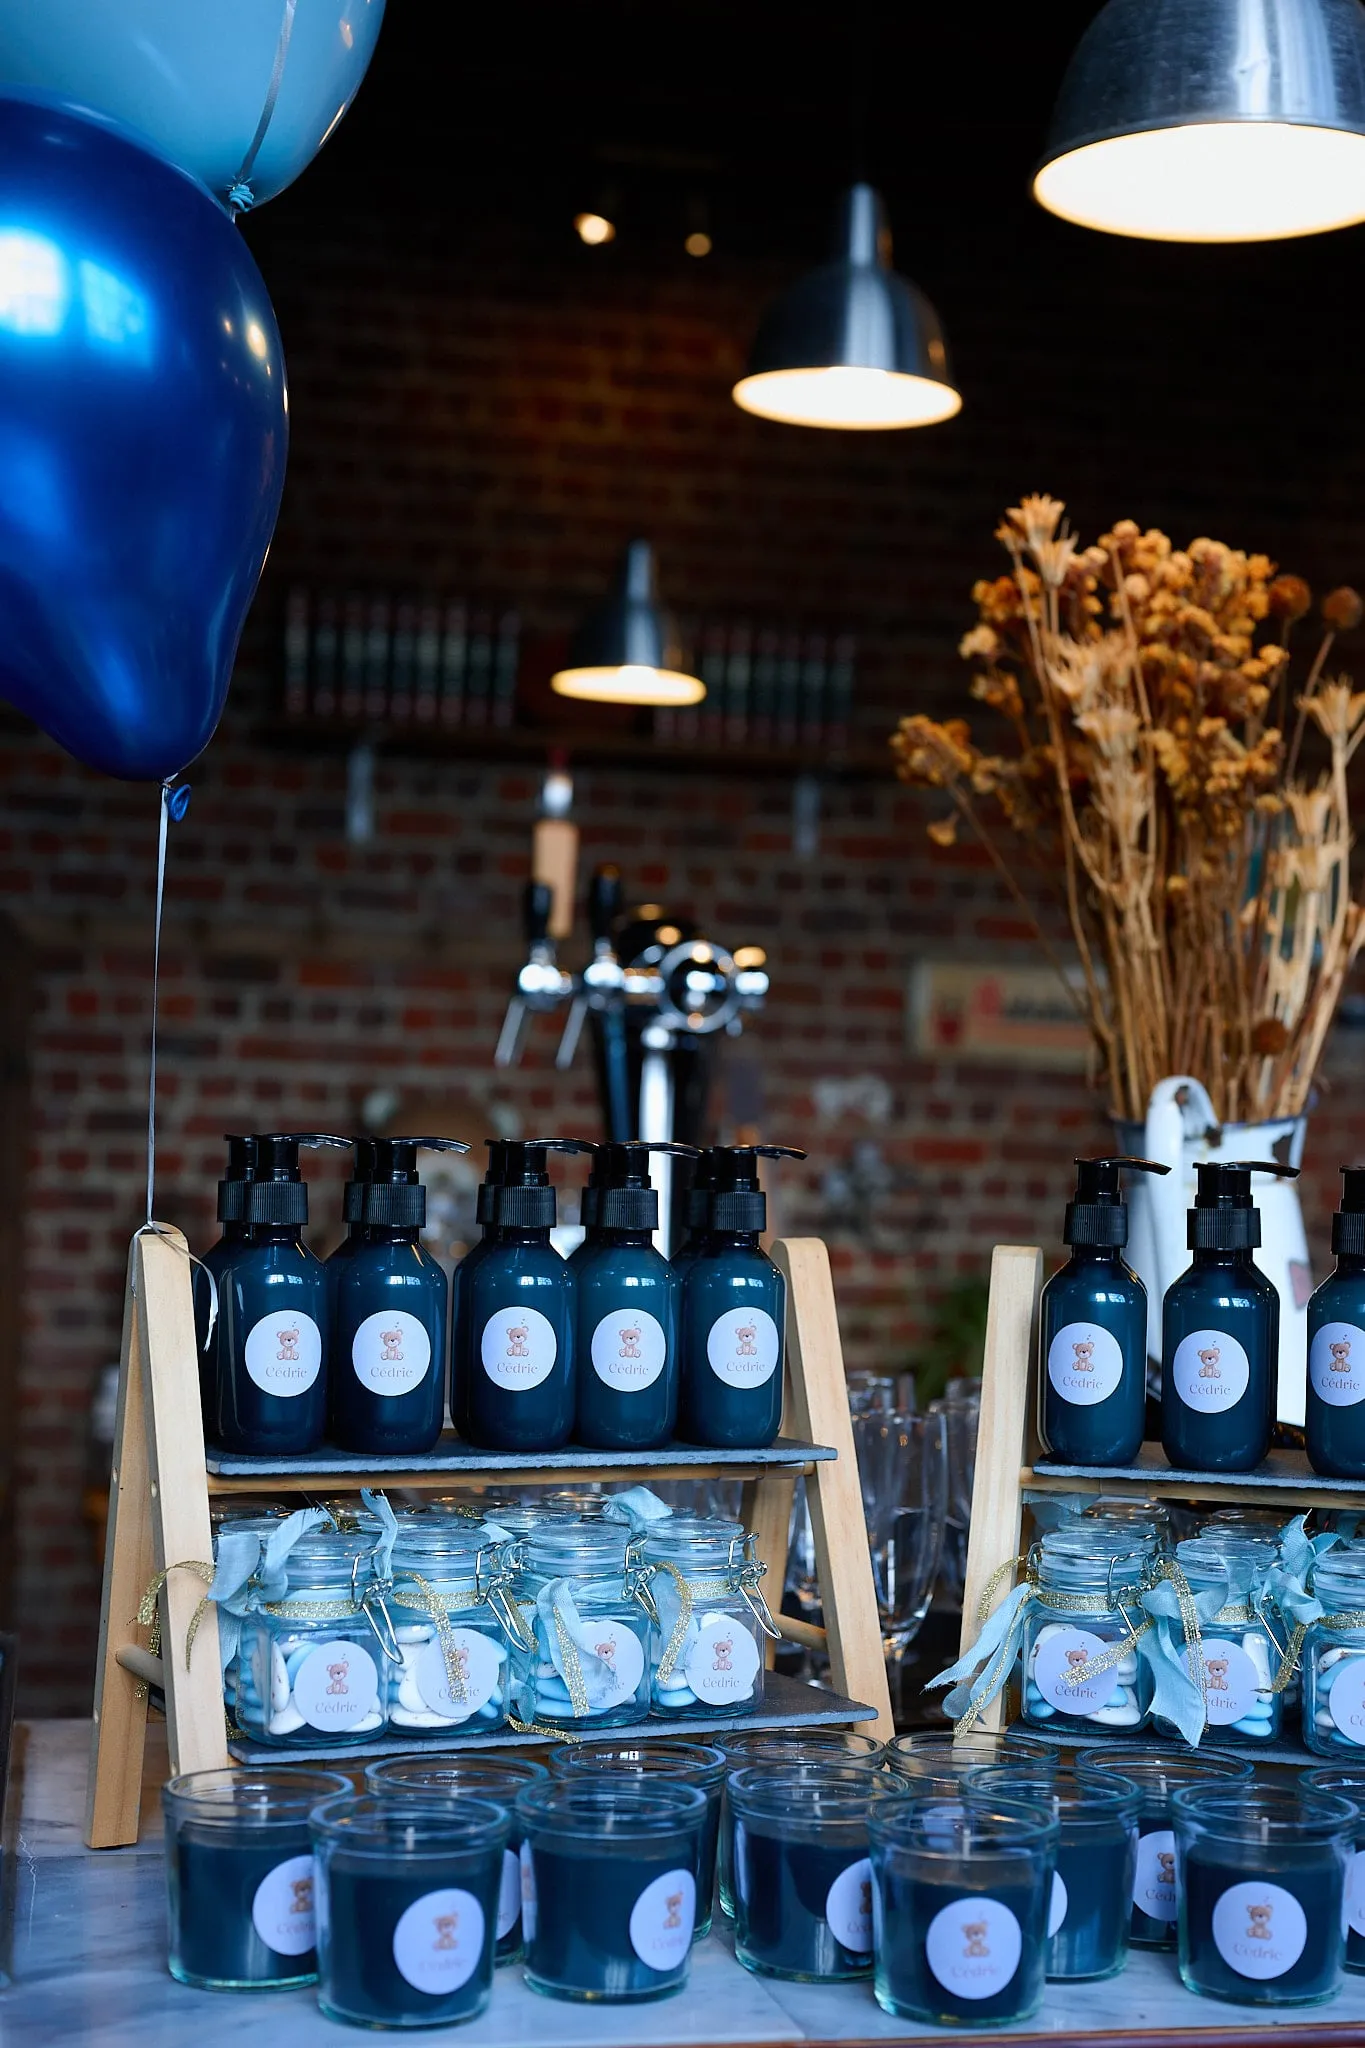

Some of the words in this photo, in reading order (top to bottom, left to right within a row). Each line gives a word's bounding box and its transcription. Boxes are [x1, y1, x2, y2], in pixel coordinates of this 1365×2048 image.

[265, 1366, 308, 1379] Cédric
[370, 1366, 413, 1379] Cédric
[497, 1362, 538, 1375] Cédric
[608, 1363, 649, 1376] Cédric
[1062, 1375, 1103, 1390] Cédric
[1321, 1377, 1360, 1391] Cédric
[1189, 1383, 1231, 1396] Cédric
[1204, 1696, 1238, 1710] édric
